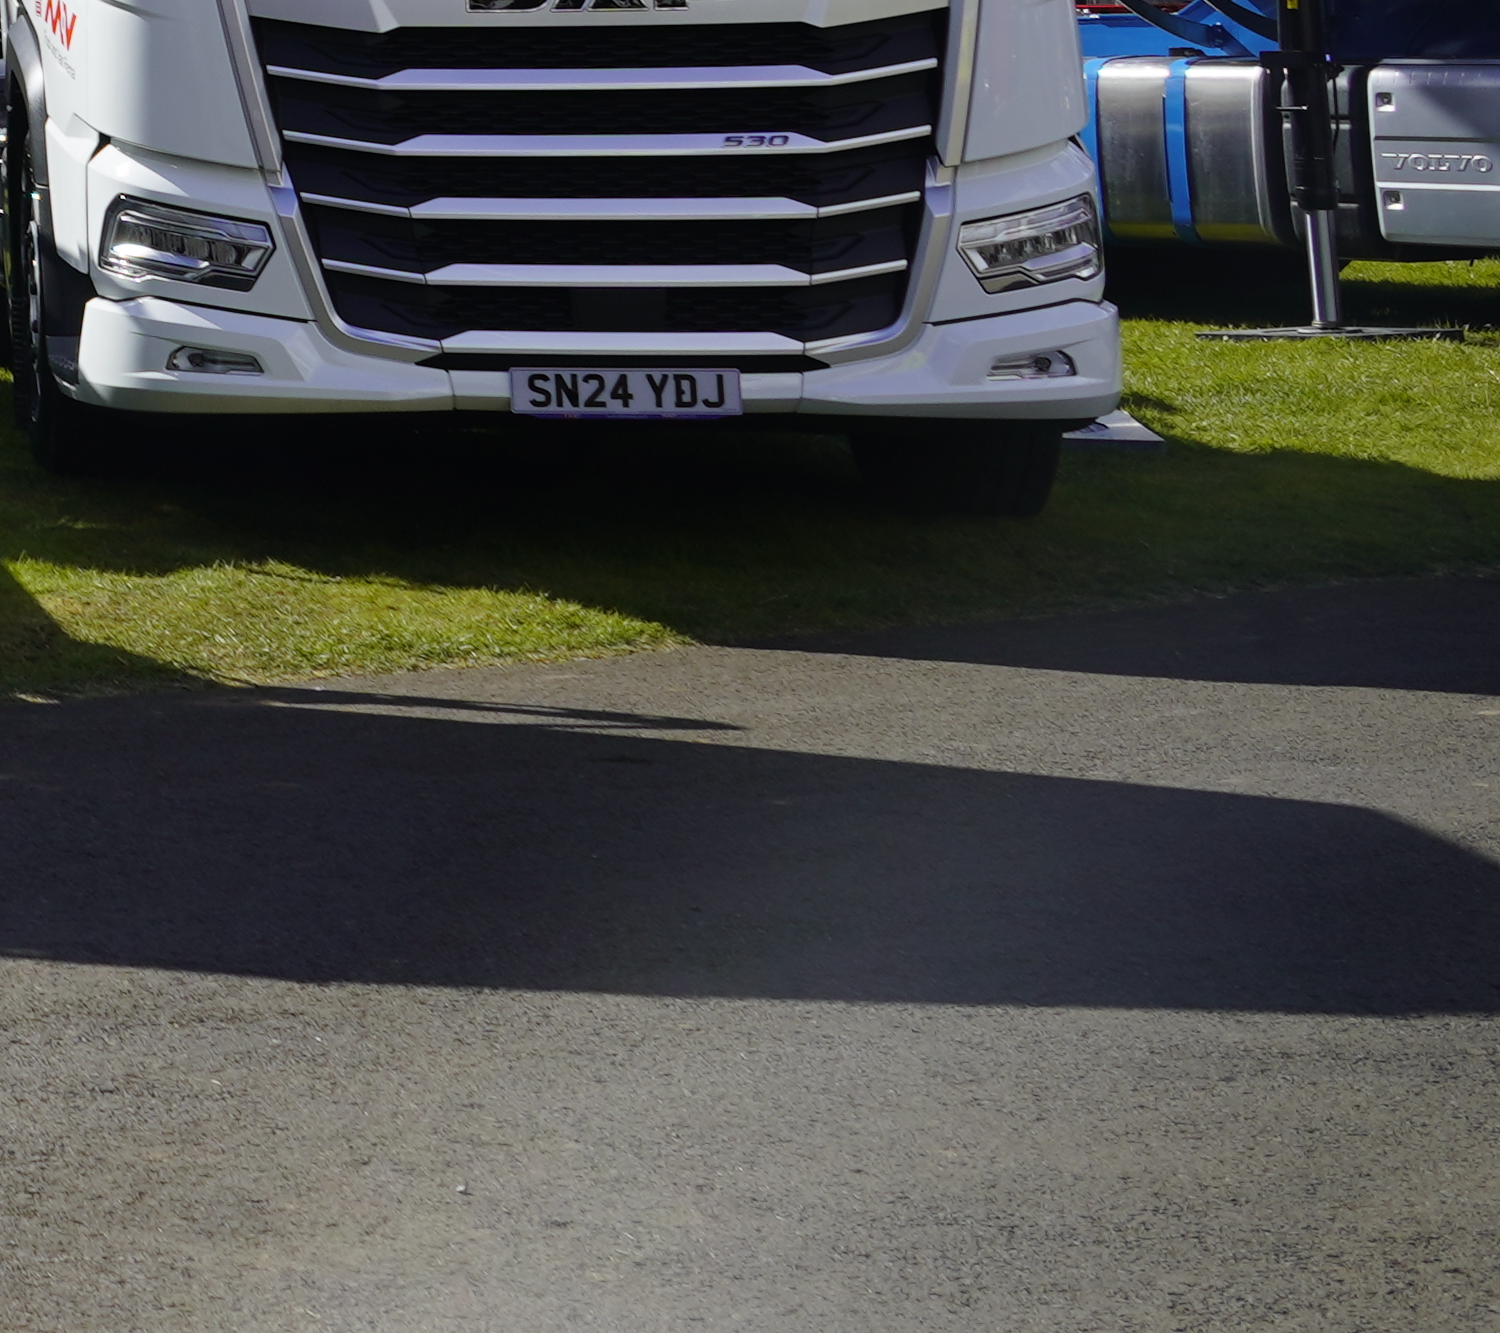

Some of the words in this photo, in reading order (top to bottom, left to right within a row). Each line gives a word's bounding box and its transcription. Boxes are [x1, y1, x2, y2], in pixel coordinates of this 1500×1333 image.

[723, 135, 790, 148] 530
[1381, 153, 1493, 172] VOLVO
[527, 373, 633, 408] SN24
[646, 373, 726, 408] YDJ
